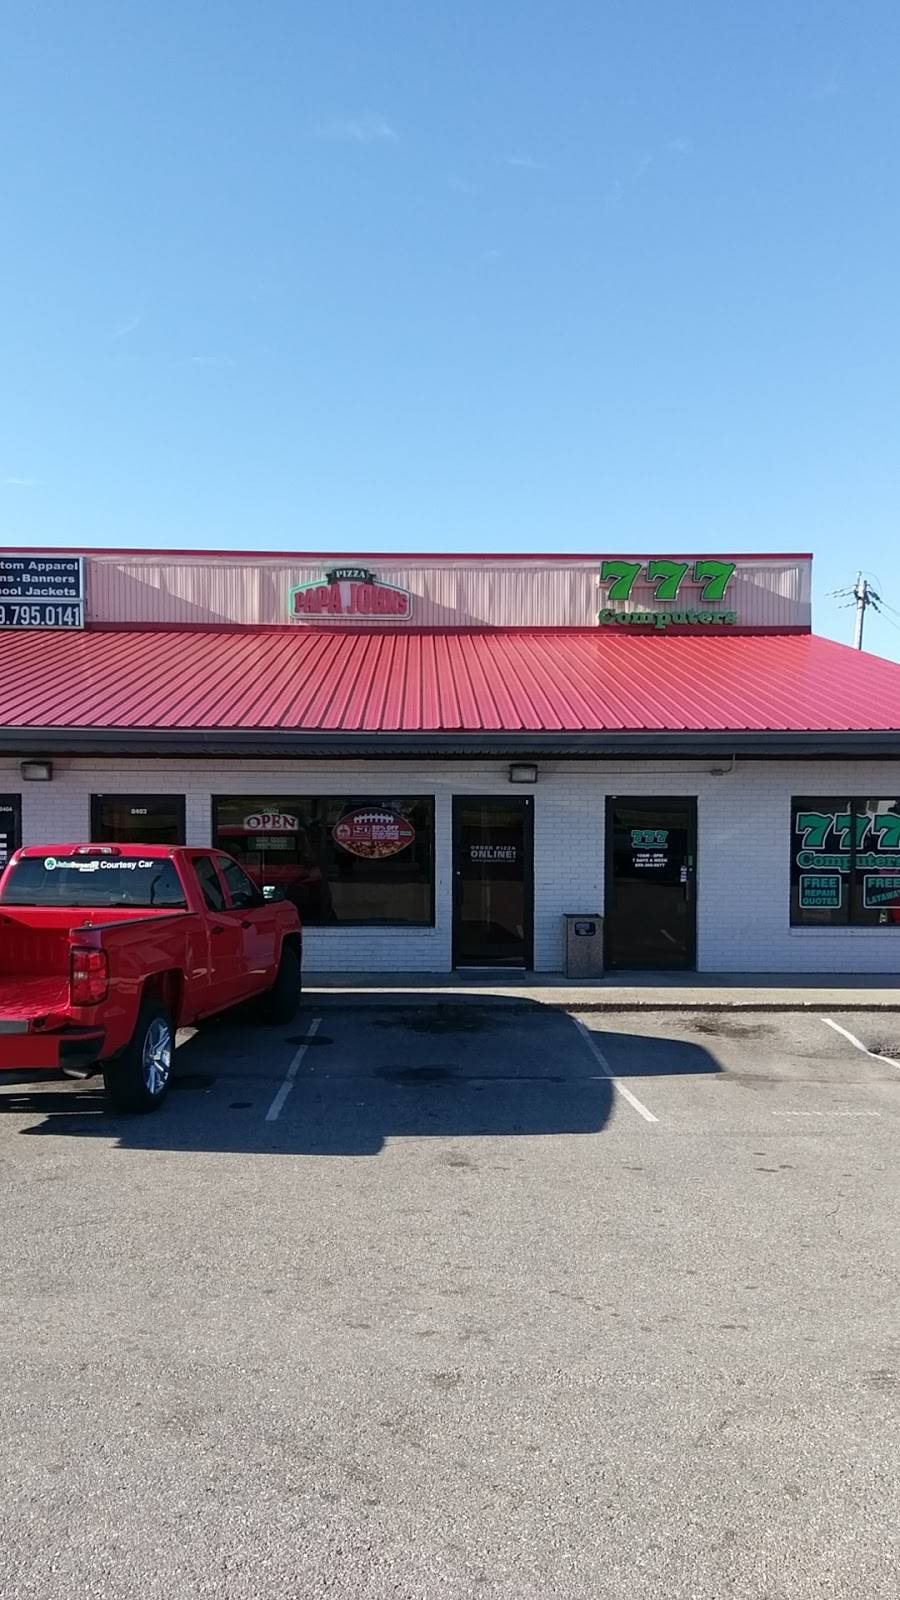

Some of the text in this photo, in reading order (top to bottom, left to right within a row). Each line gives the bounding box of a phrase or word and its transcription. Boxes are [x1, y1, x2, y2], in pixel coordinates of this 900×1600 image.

[28, 561, 78, 571] Apparel
[22, 573, 75, 583] Banners
[336, 569, 366, 579] PIZZA
[25, 586, 76, 596] Jackets
[294, 583, 341, 613] PAPA
[598, 609, 737, 629] Computers
[247, 814, 295, 829] OPEN
[631, 829, 668, 843] 777
[470, 850, 516, 859] ONLINE!
[100, 861, 137, 870] Courtesy
[138, 860, 153, 868] Car
[804, 878, 838, 888] FREE
[802, 897, 838, 905] QUOTES
